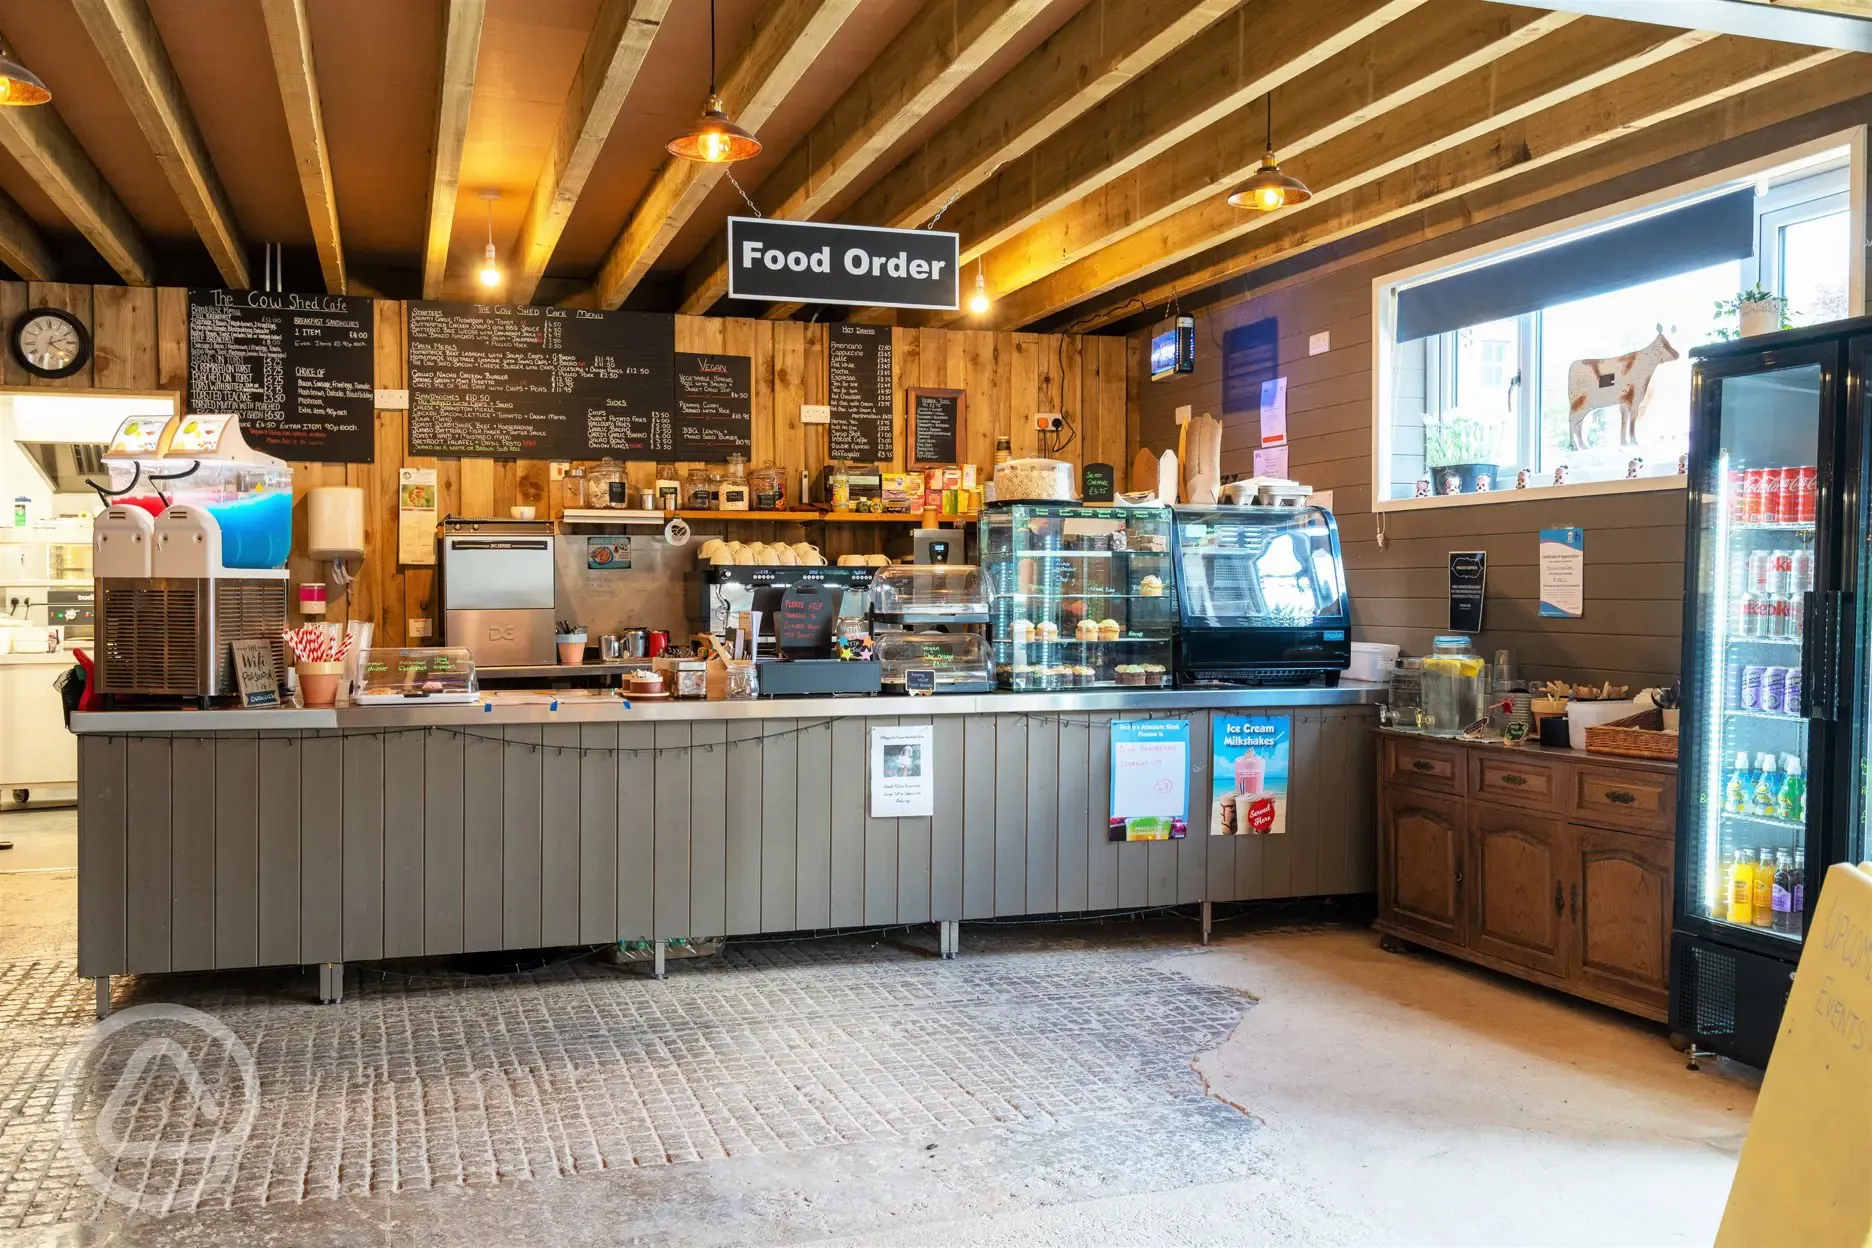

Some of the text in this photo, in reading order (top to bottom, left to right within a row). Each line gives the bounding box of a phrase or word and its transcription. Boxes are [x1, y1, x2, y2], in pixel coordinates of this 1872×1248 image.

[742, 240, 946, 280] Food Order
[209, 289, 234, 306] The
[289, 293, 320, 310] Shed
[323, 296, 348, 311] Cafe
[294, 317, 360, 328] BREAKFAST SANDWICHES
[302, 328, 321, 336] ITEM
[434, 343, 458, 351] MEALS
[831, 341, 863, 350] Americano
[697, 358, 727, 372] VEGAN
[191, 371, 223, 382] POACHED
[234, 373, 253, 383] TOAST
[295, 366, 326, 377] CHOICE OF
[831, 374, 856, 382] Espresso
[191, 380, 208, 391] TOAST
[191, 390, 252, 402] TOASTED TEACAKE
[415, 392, 460, 401] SANDWICHES
[191, 399, 216, 410] TOASTED
[255, 402, 281, 411] POACHED
[1226, 723, 1275, 733] Ice Cream
[1224, 736, 1275, 746] Milkshakes
[1249, 803, 1271, 819] Served
[1814, 975, 1868, 1050] EVENTS
